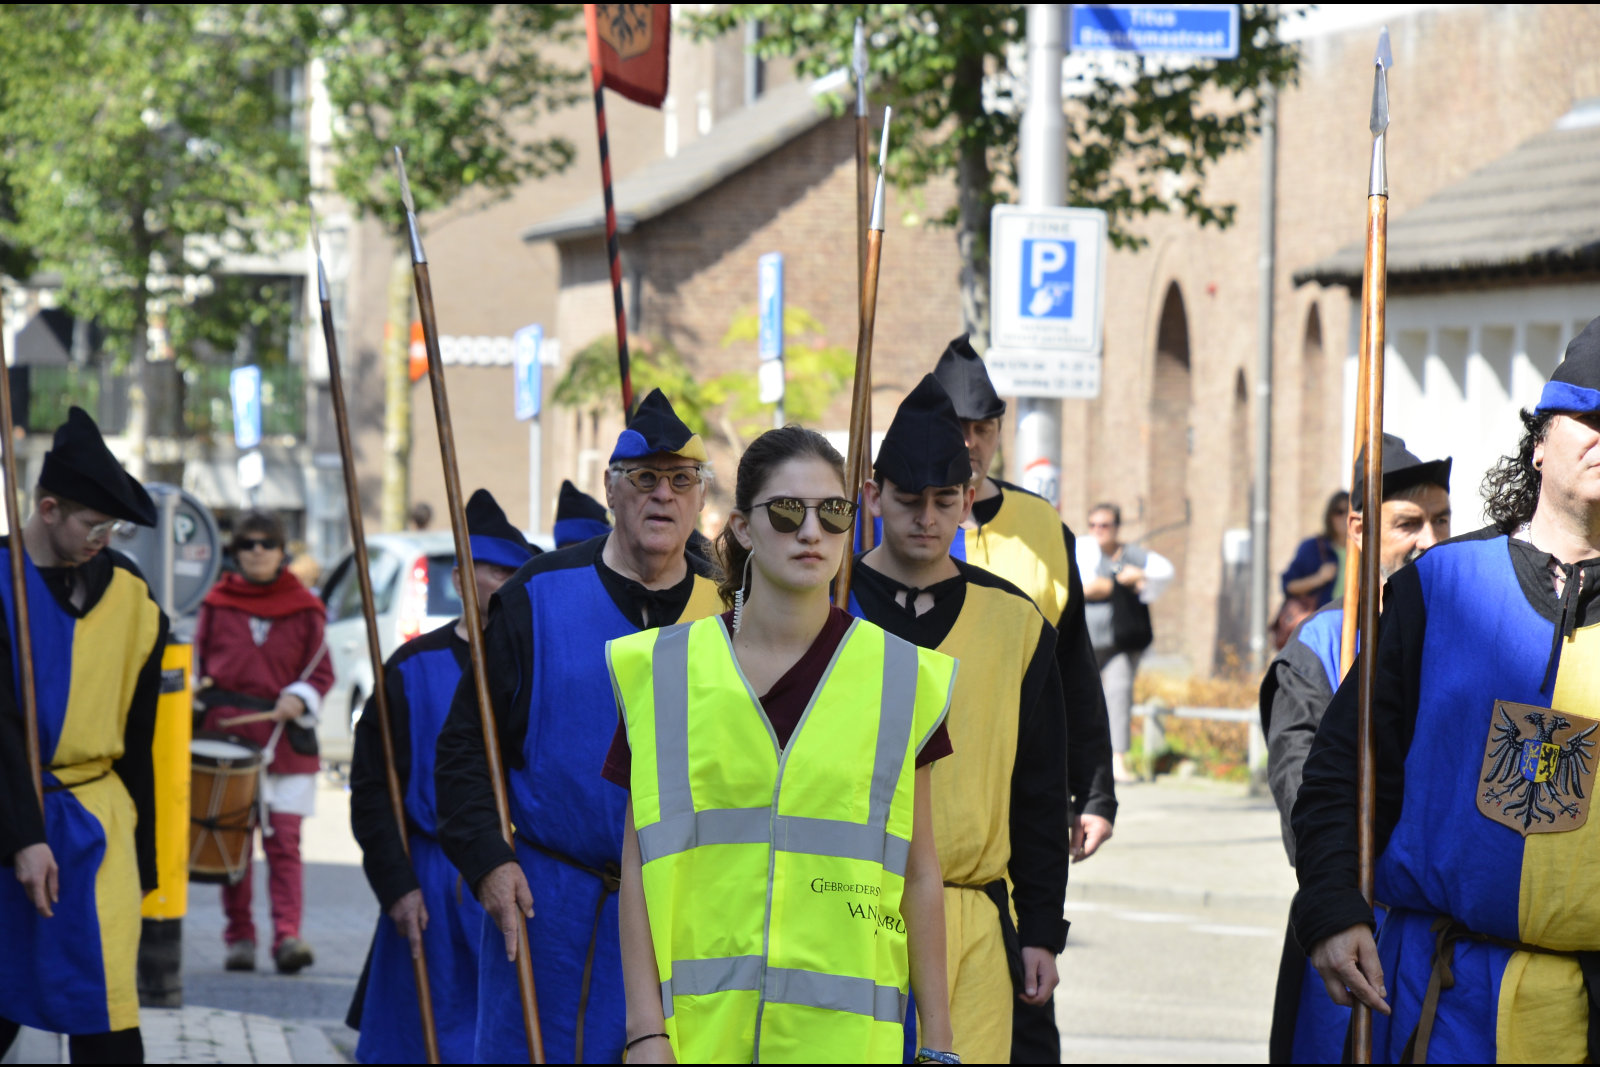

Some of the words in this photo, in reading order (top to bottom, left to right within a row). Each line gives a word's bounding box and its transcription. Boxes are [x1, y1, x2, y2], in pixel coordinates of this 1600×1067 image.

[1130, 10, 1177, 27] Titus
[1030, 241, 1067, 289] P
[174, 514, 194, 544] P
